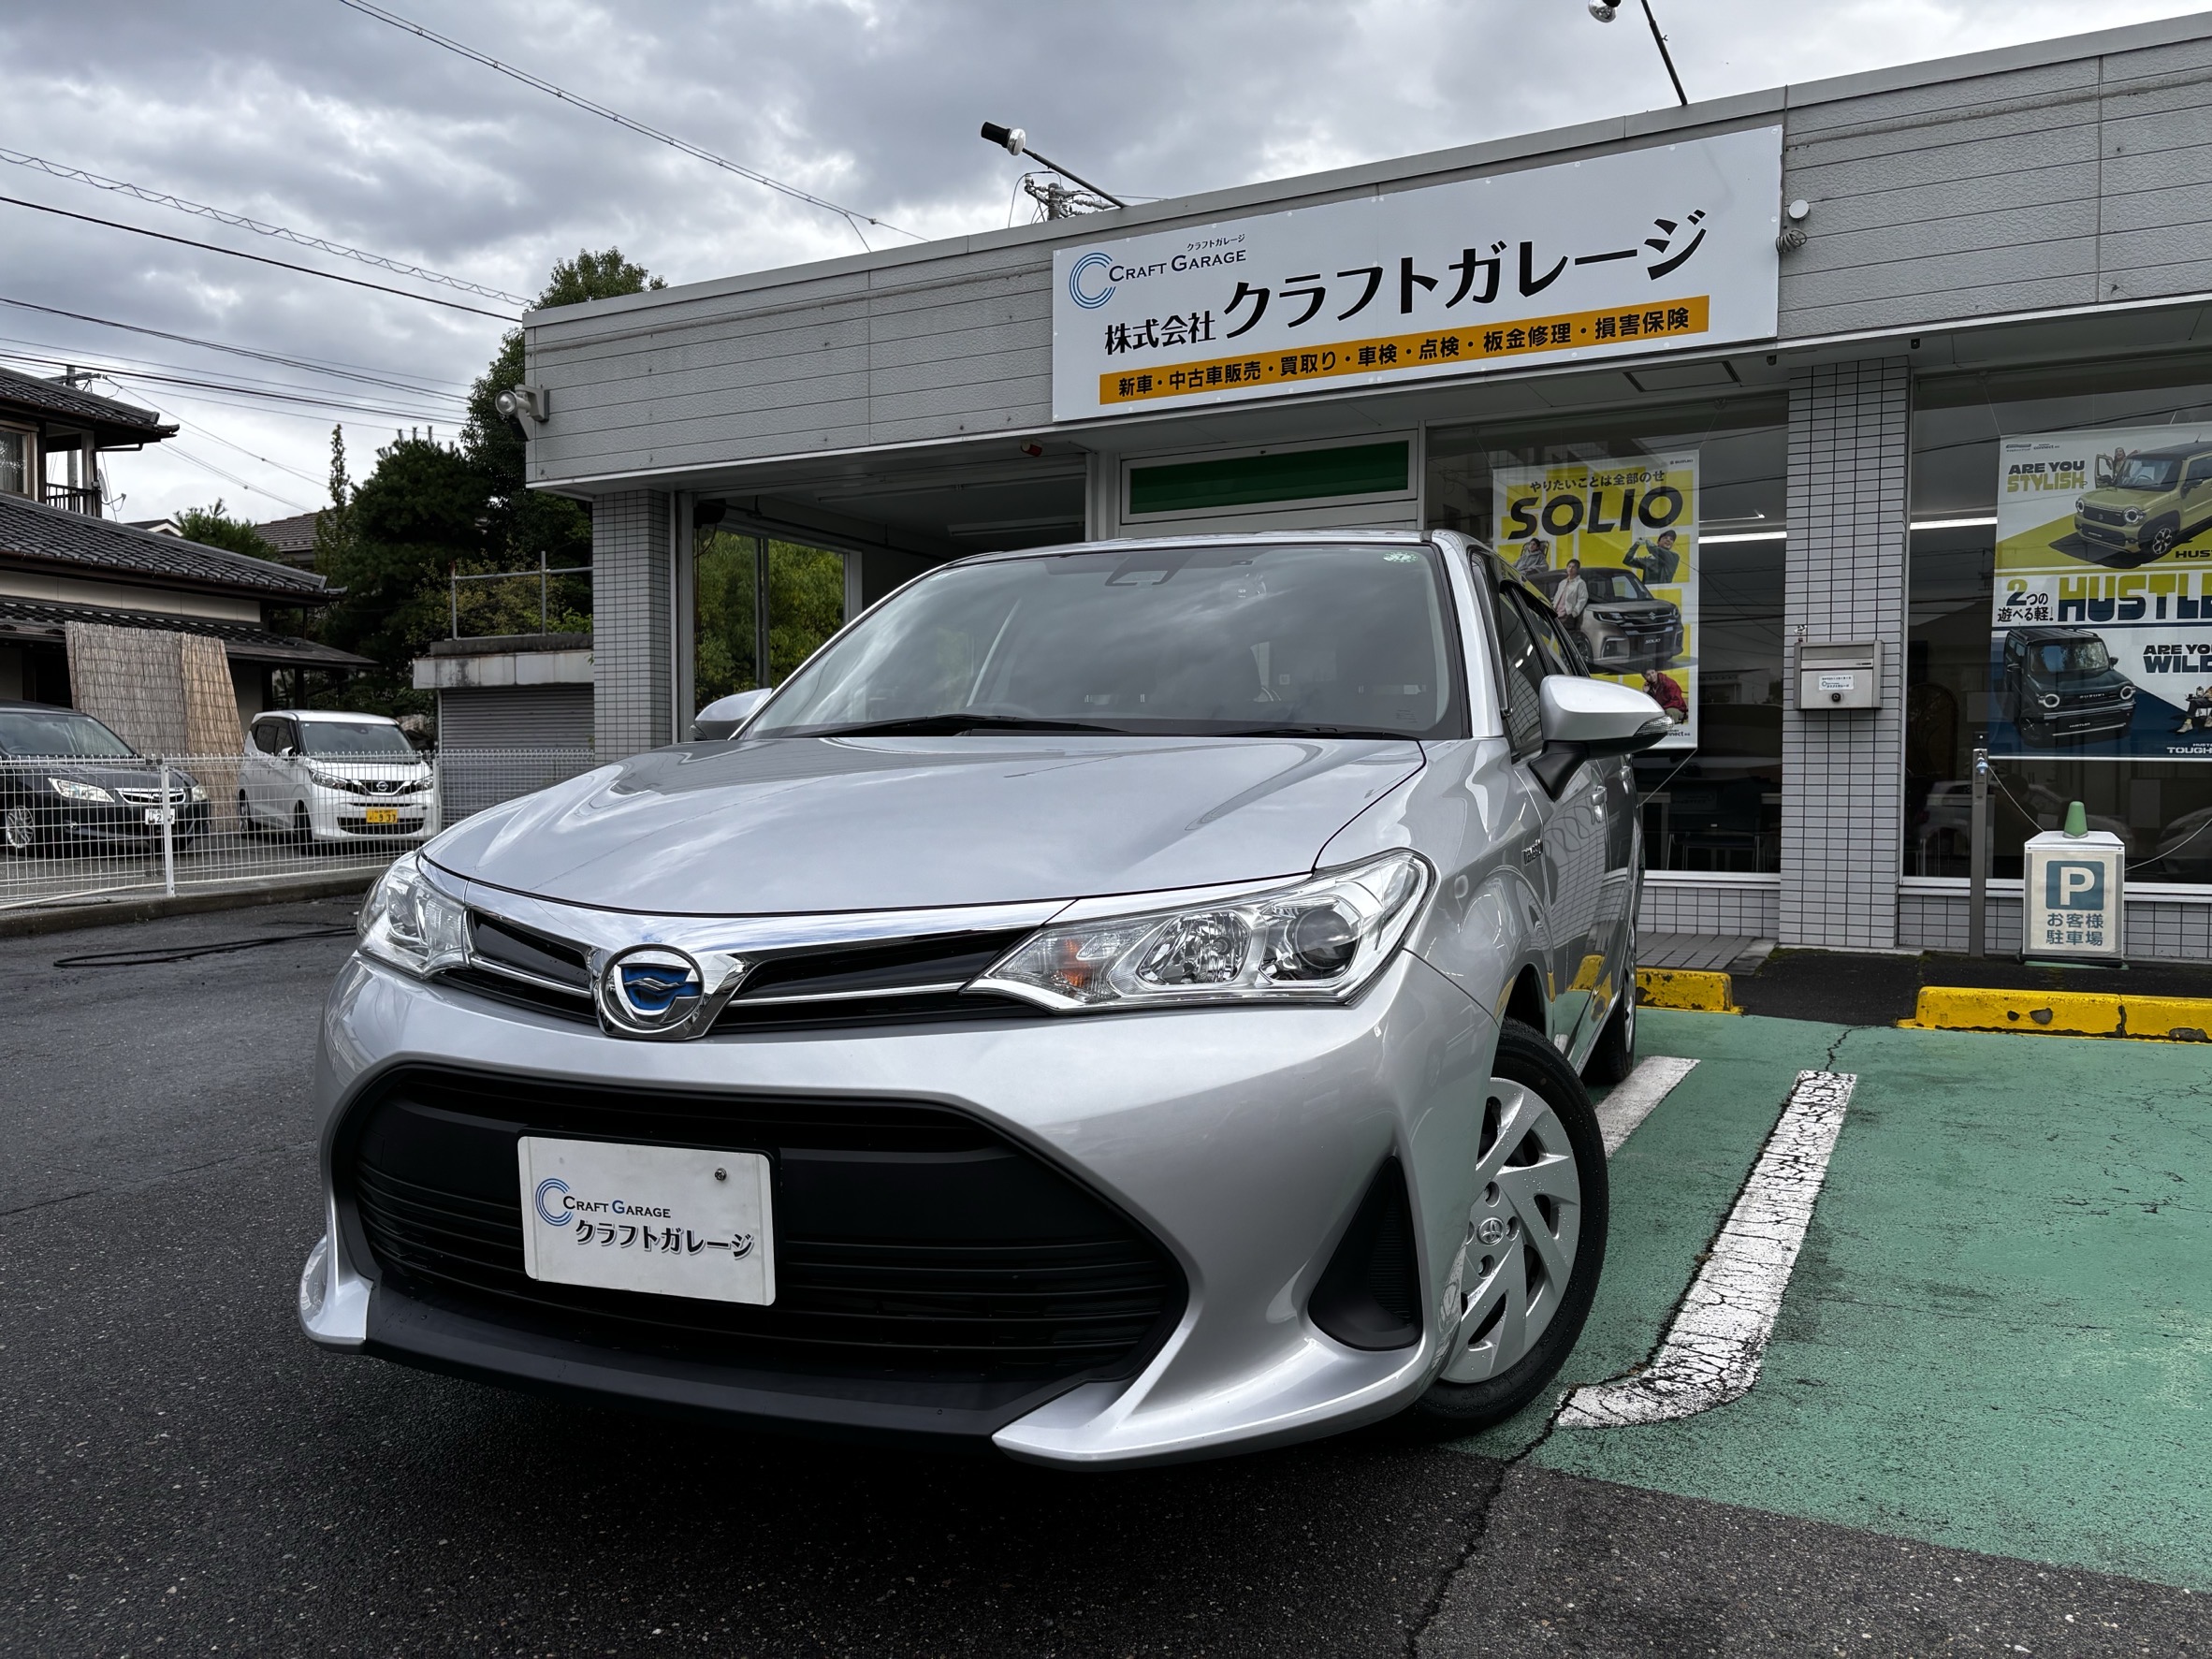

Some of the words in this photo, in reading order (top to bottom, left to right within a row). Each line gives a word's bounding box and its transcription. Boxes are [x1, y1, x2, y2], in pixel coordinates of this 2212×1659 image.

[1186, 234, 1245, 251] クラフトガレージ
[1109, 263, 1167, 282] CRAFT
[1171, 250, 1246, 271] GARAGE
[2008, 462, 2045, 474] ARE
[2048, 460, 2085, 472] YOU
[1530, 469, 1665, 493] やりたいことは全部のせ
[1507, 486, 1683, 540] SOLIO
[2175, 549, 2212, 559] HUS
[2006, 578, 2048, 606] 2つの
[2143, 644, 2183, 655] ARE
[2186, 644, 2212, 655] YO
[2059, 866, 2095, 906] P
[2047, 913, 2103, 929] お客様
[2046, 930, 2103, 947] 駐車場
[562, 1195, 609, 1214] CRAFT
[612, 1200, 672, 1218] GARAGE
[575, 1218, 754, 1260] クラフトガレージ
